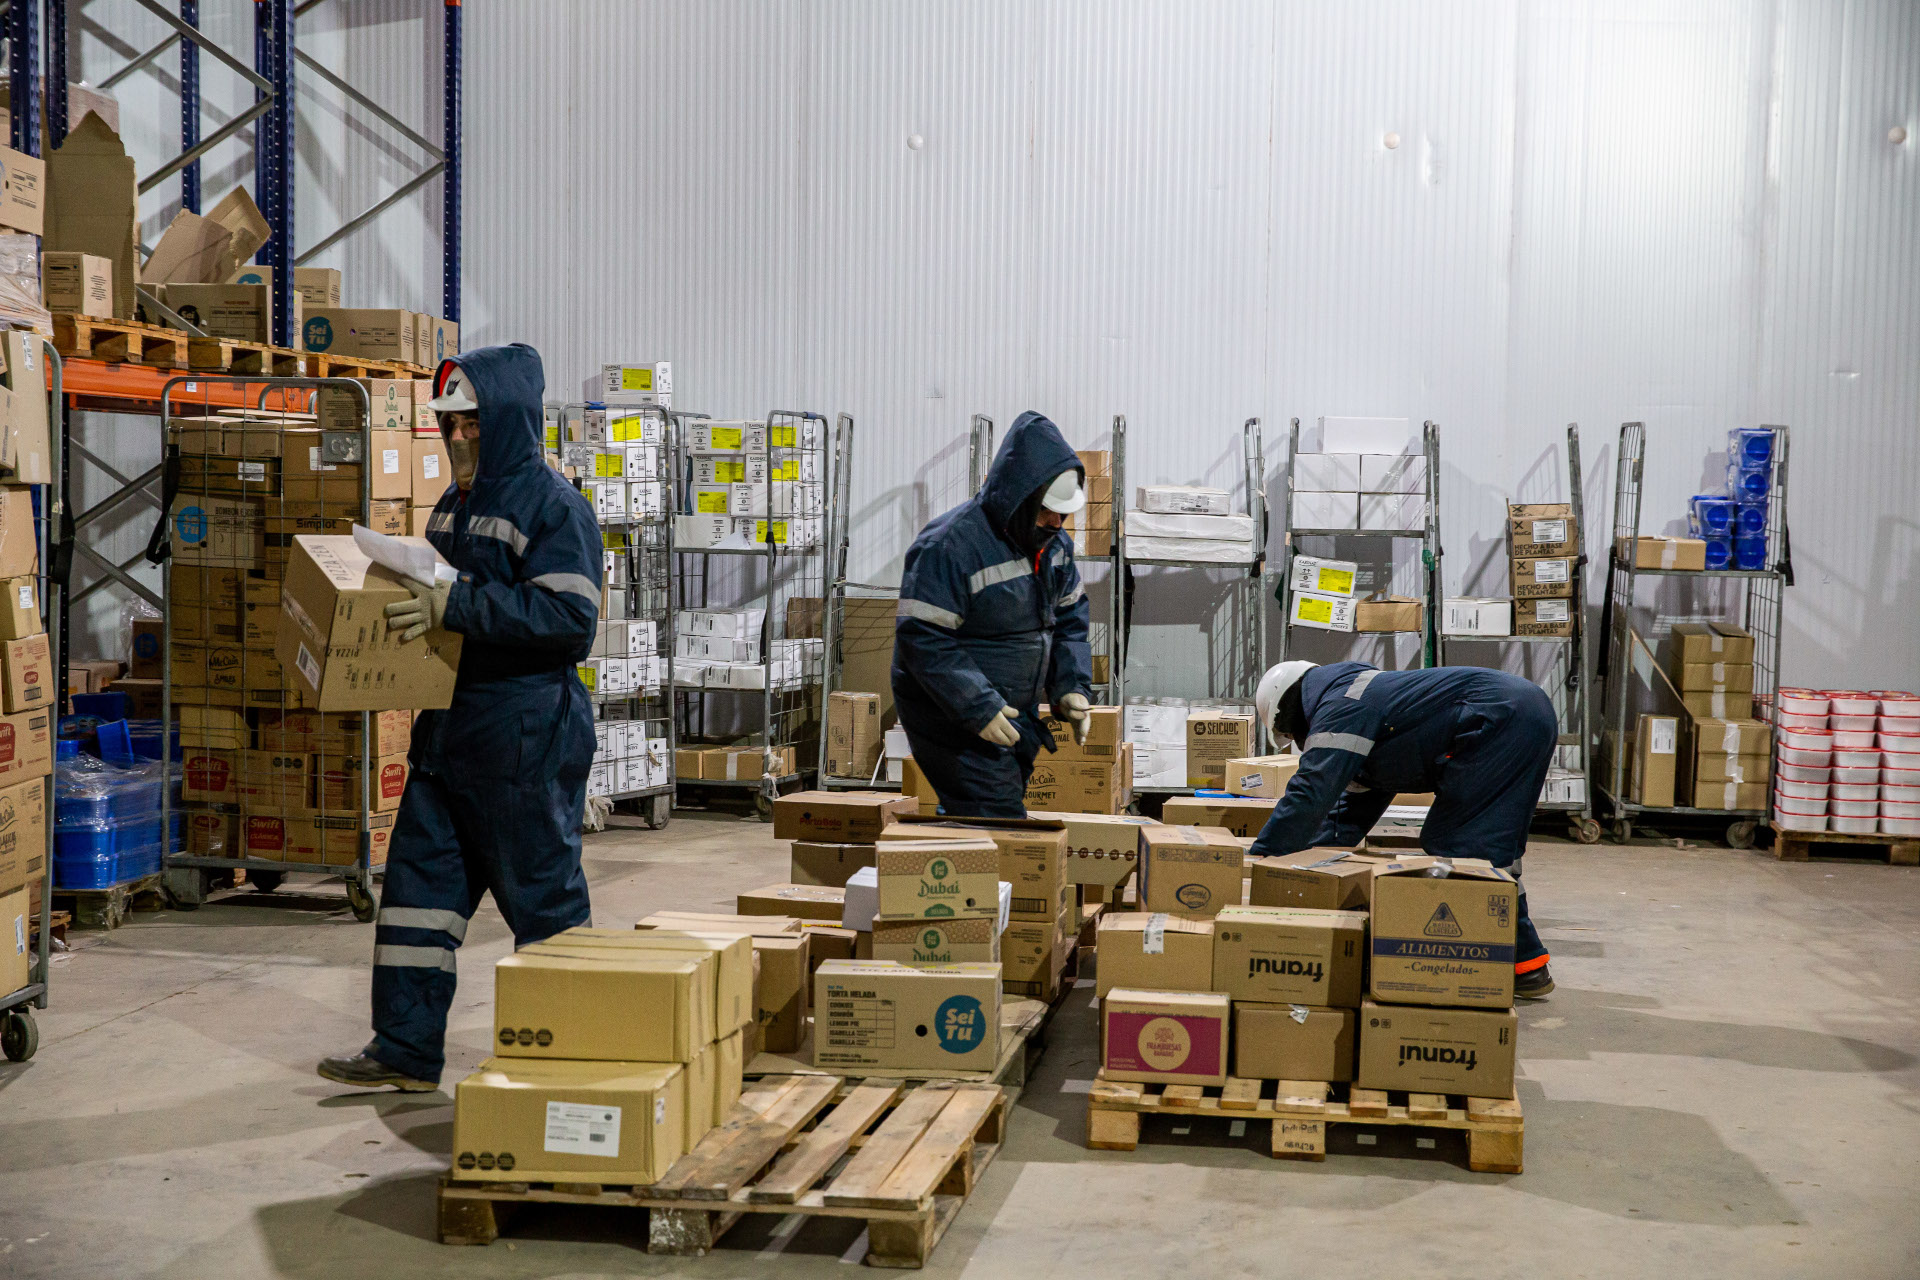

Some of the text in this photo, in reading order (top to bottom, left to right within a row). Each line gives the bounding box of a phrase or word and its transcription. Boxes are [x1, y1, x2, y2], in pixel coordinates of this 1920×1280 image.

[308, 324, 328, 335] Sei
[296, 517, 337, 531] Simplot
[321, 558, 353, 583] PIZZA
[193, 758, 222, 771] Swift
[383, 766, 402, 778] Swift
[250, 818, 280, 829] Swift
[918, 879, 961, 898] Dubai
[1396, 942, 1490, 958] ALIMENTOS
[827, 990, 877, 999] TORTA HELADA
[945, 1008, 976, 1025] Sei
